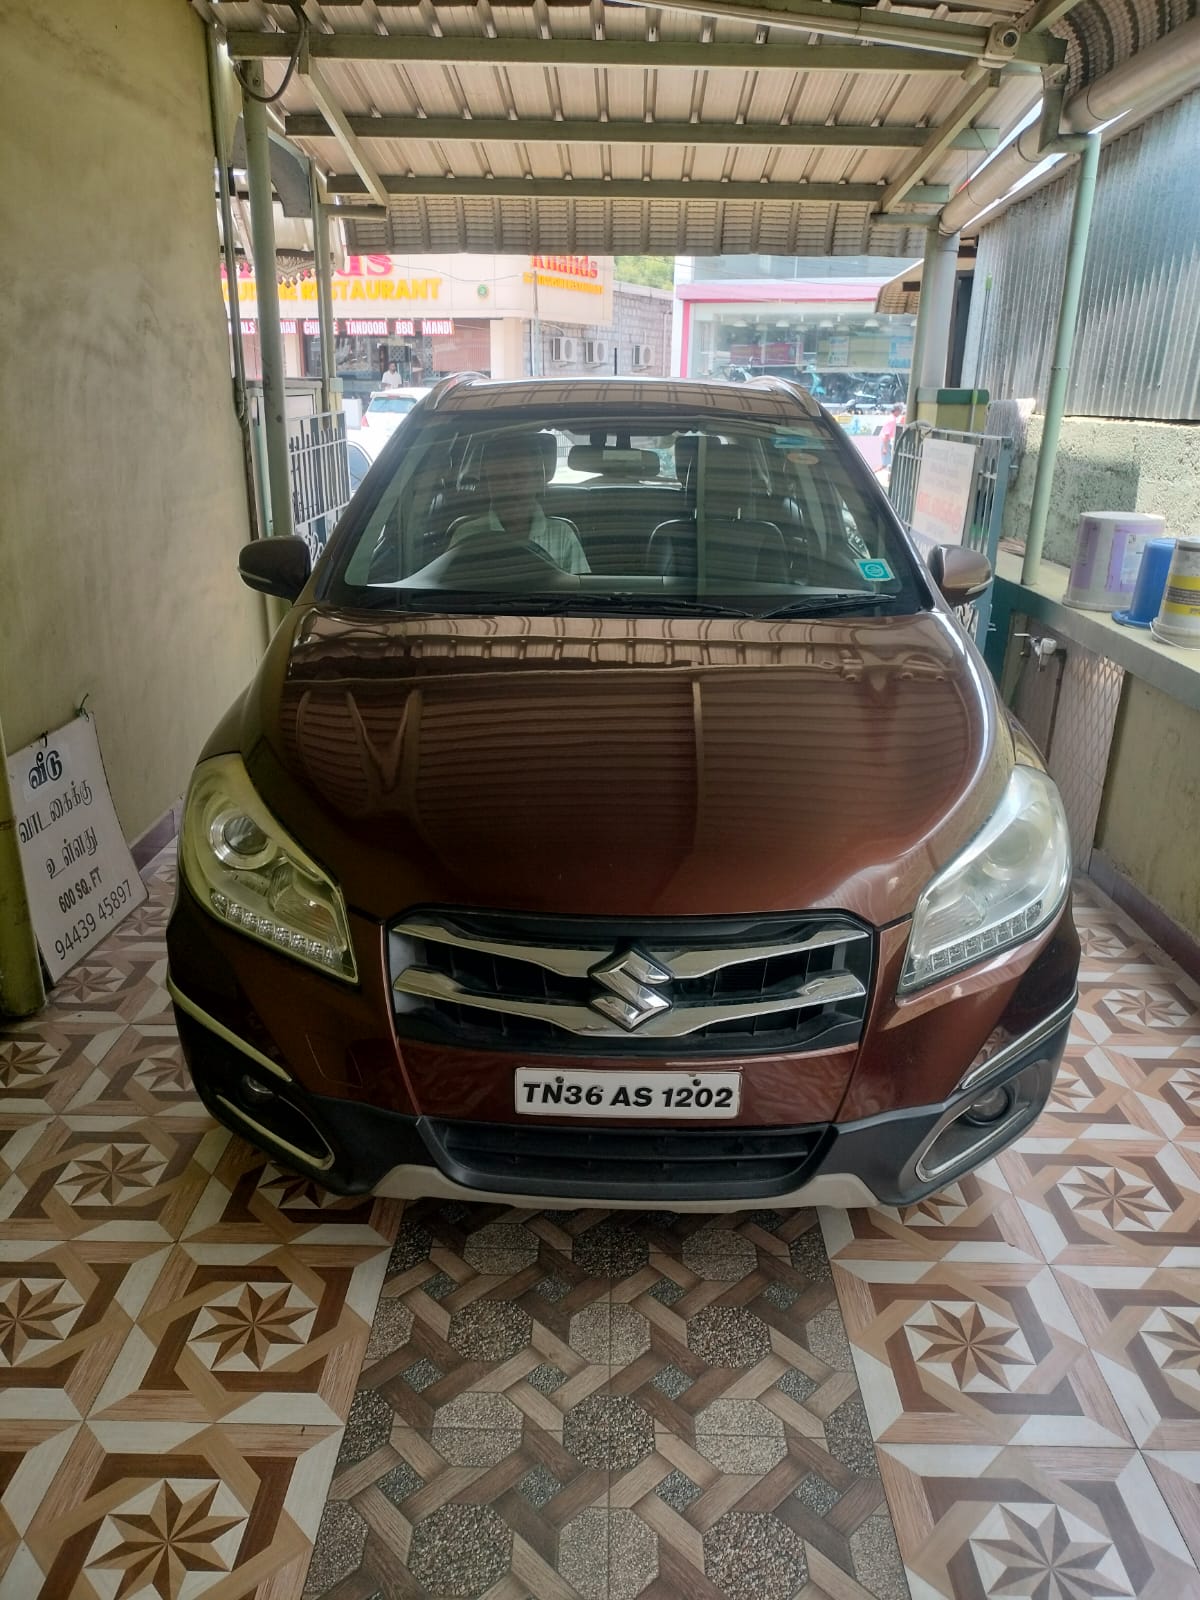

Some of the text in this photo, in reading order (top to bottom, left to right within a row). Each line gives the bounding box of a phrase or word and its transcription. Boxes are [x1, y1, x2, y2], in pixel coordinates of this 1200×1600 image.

[345, 321, 388, 335] TANDOORI
[395, 321, 414, 335] BBQ
[422, 321, 452, 335] MANDI
[28, 750, 63, 789] வீடு
[18, 779, 93, 844] வாடகைக்கு
[46, 826, 98, 879] உள்ளது
[58, 887, 77, 913] 600
[89, 866, 102, 888] FT
[55, 879, 132, 960] 94439 45897
[523, 1083, 734, 1108] TN36 AS 1202
